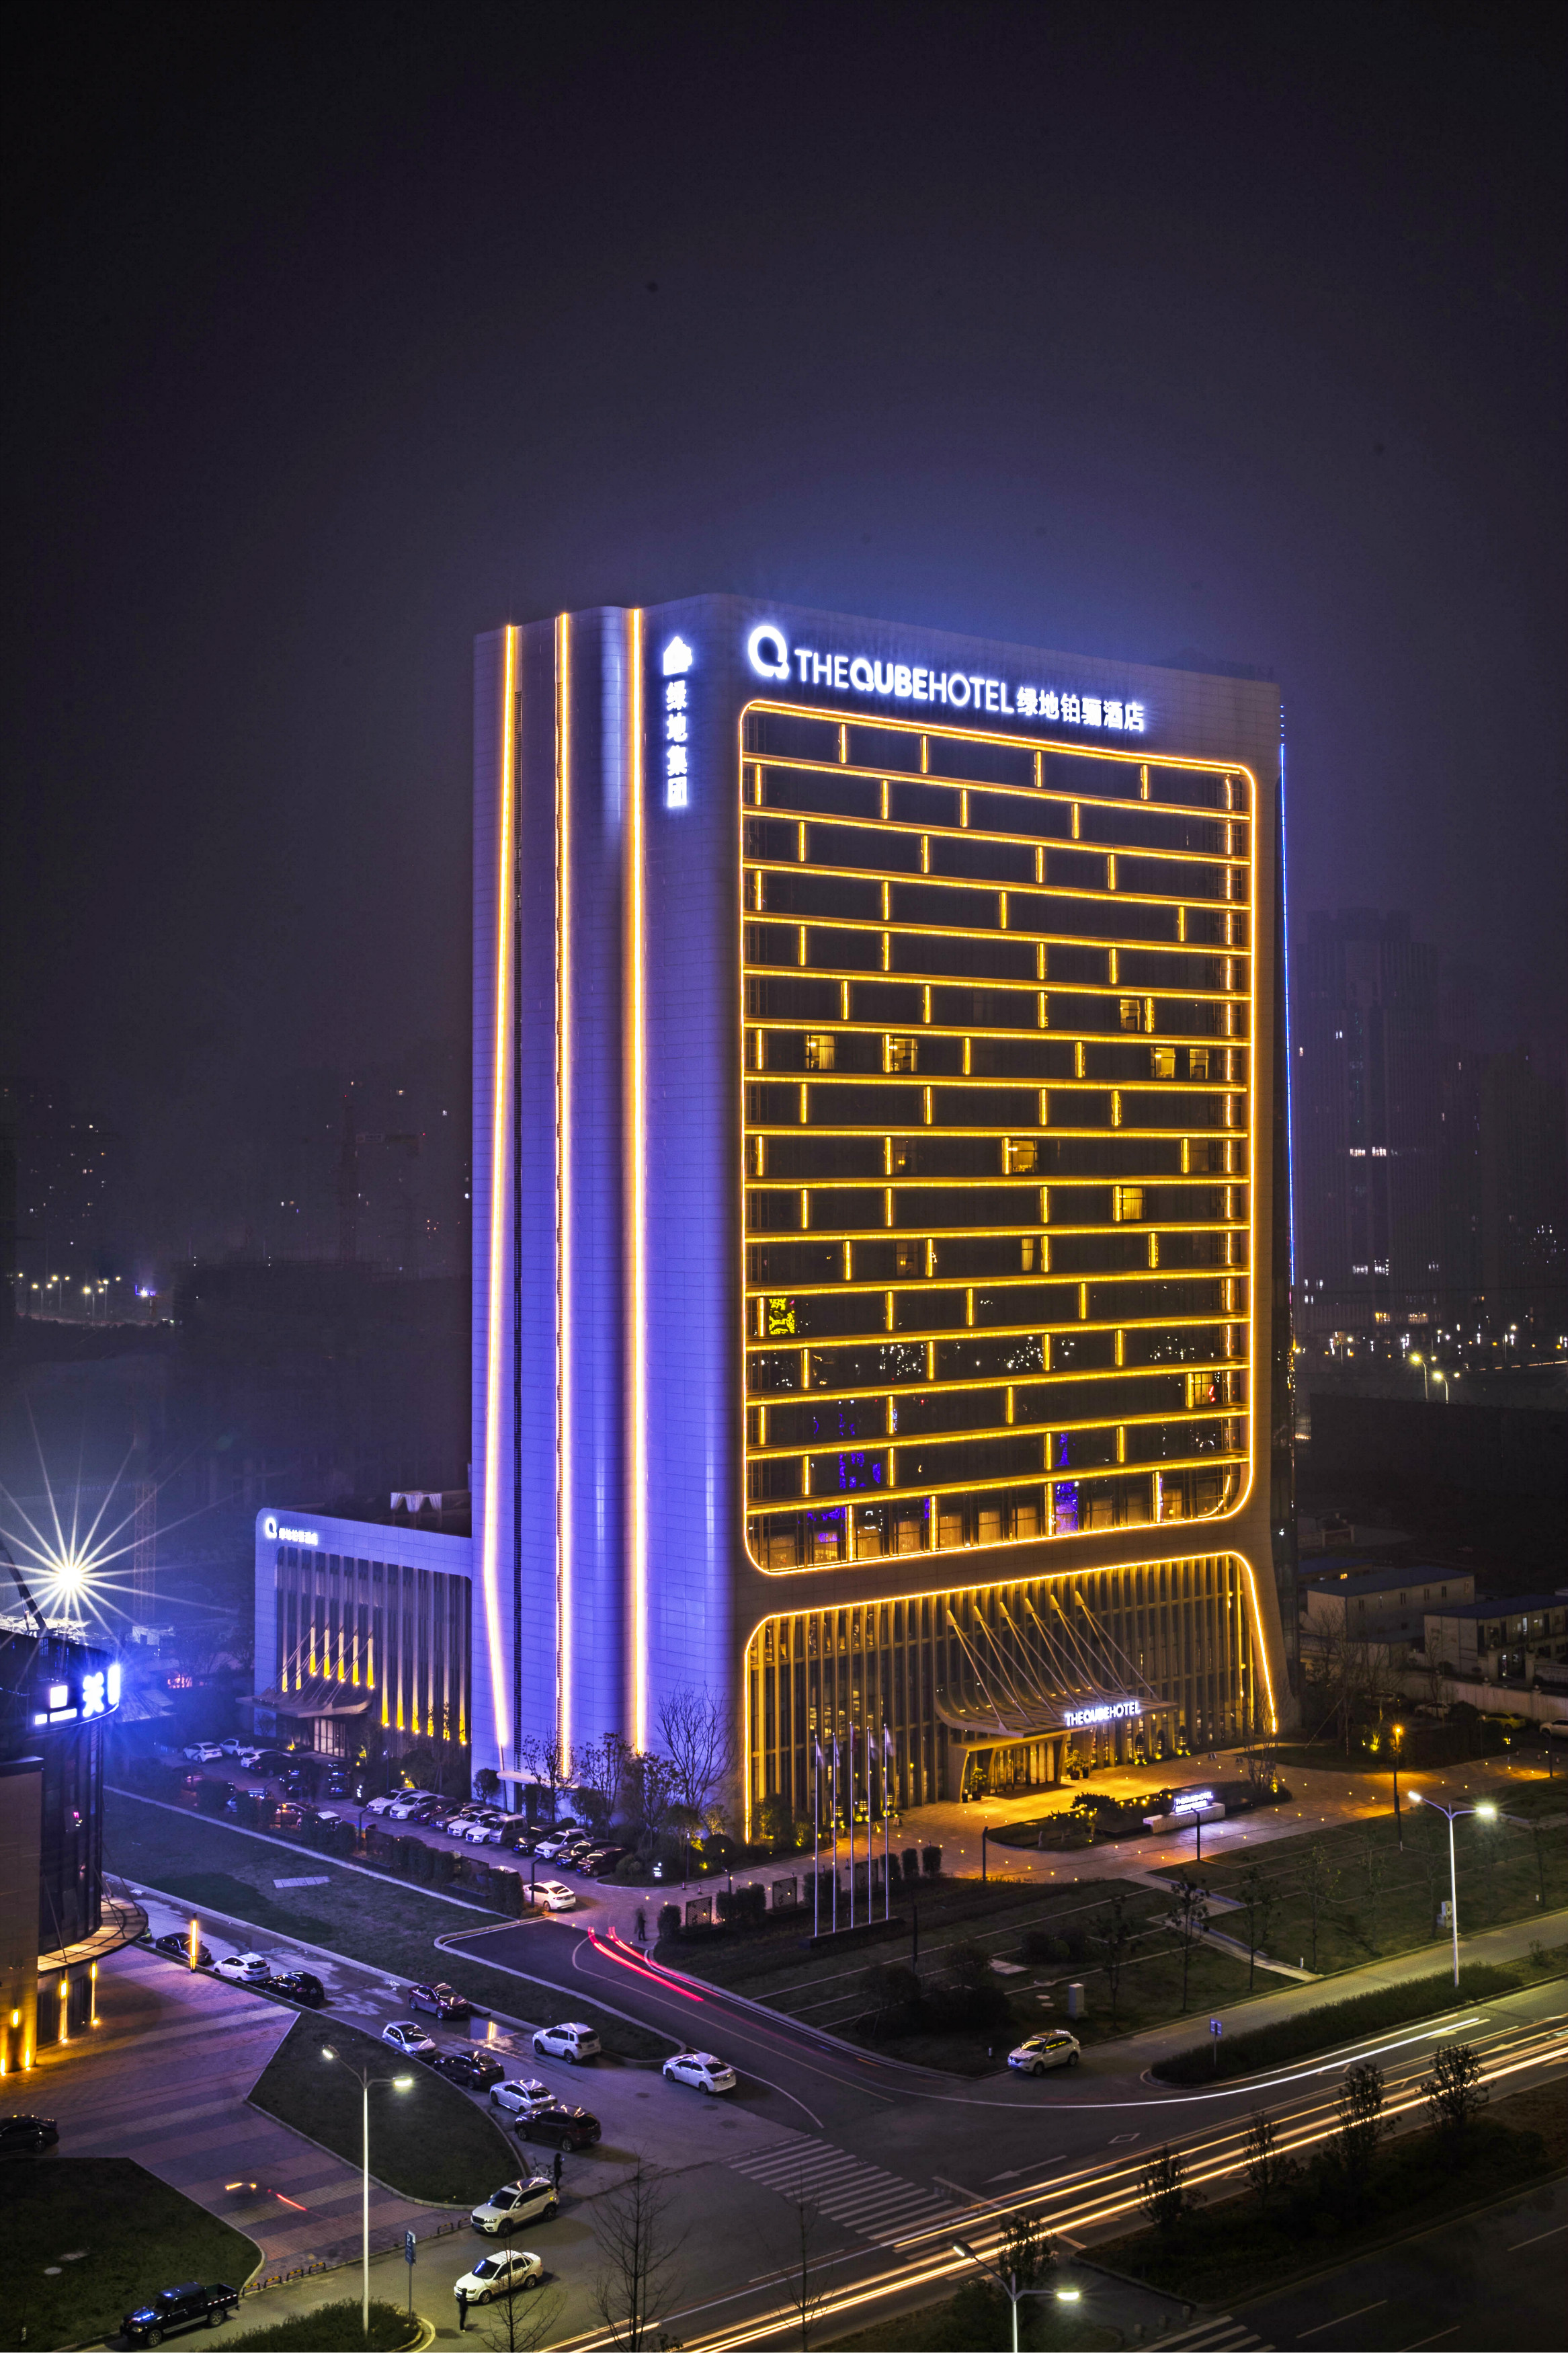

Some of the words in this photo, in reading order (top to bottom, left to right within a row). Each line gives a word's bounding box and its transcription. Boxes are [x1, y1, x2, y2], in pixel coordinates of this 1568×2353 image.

[794, 649, 1014, 713] THEQUBEHOTEL
[666, 680, 688, 807] 绿地集团
